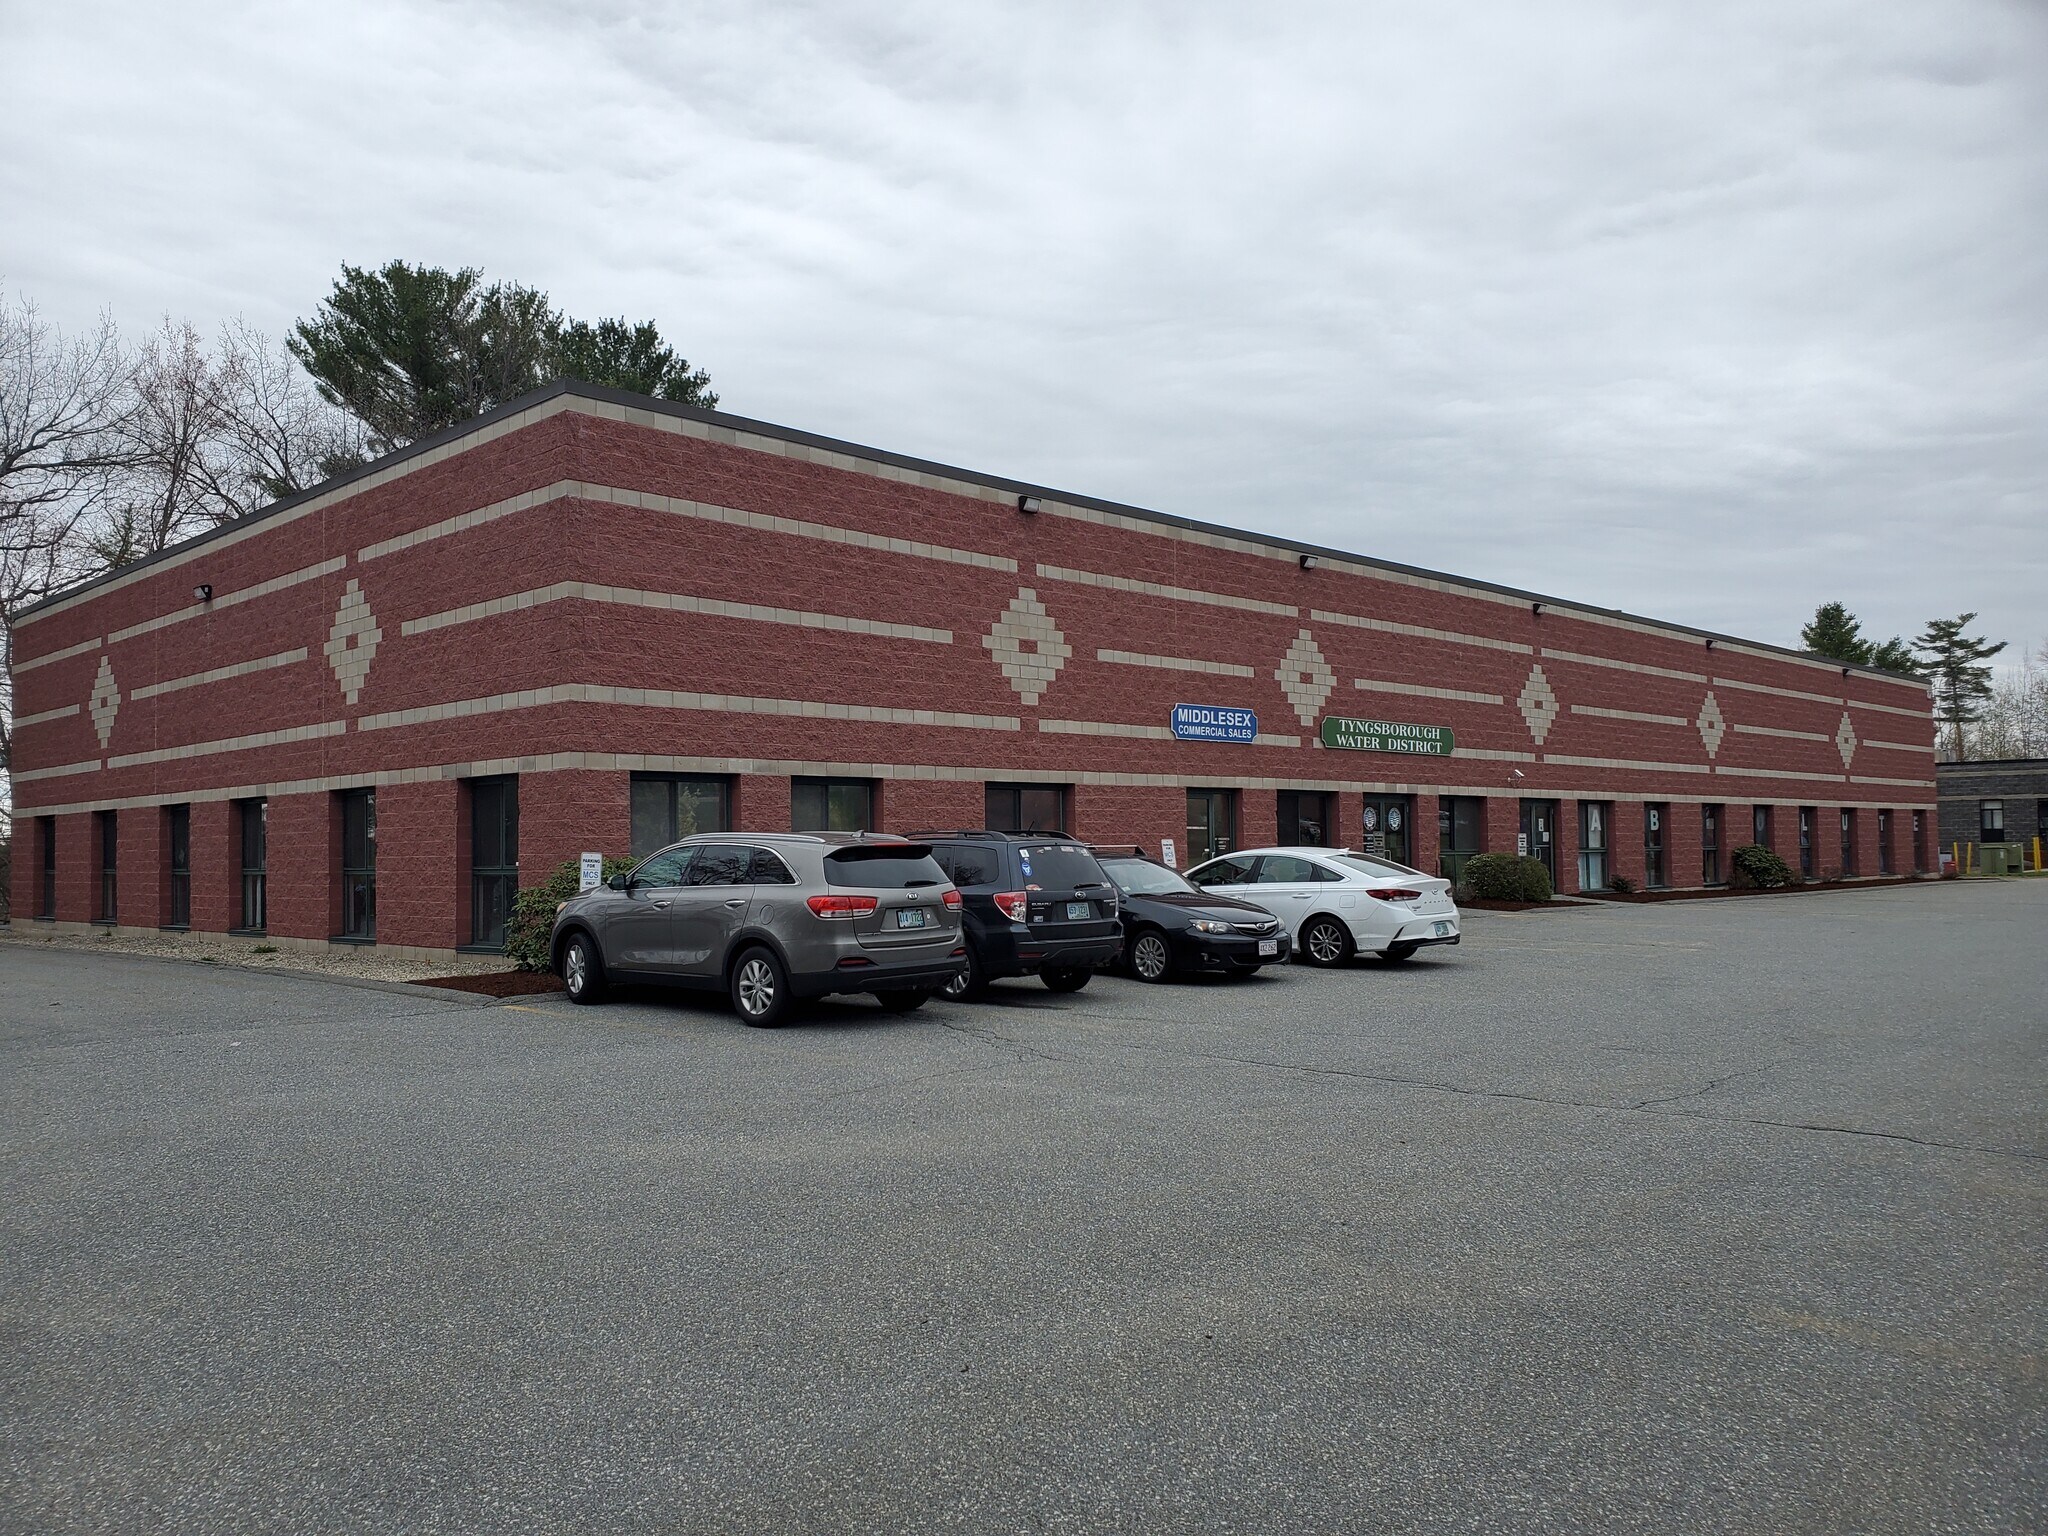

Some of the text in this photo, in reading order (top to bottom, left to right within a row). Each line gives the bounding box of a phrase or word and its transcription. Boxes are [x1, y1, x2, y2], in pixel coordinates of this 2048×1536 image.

[1178, 708, 1251, 727] MIDDLESEX
[1178, 725, 1252, 739] COMMERCIAL SALES
[1339, 719, 1441, 740] TYNGSBOROUGH
[1336, 734, 1443, 753] WATER DISTRICT
[583, 870, 599, 879] MCS
